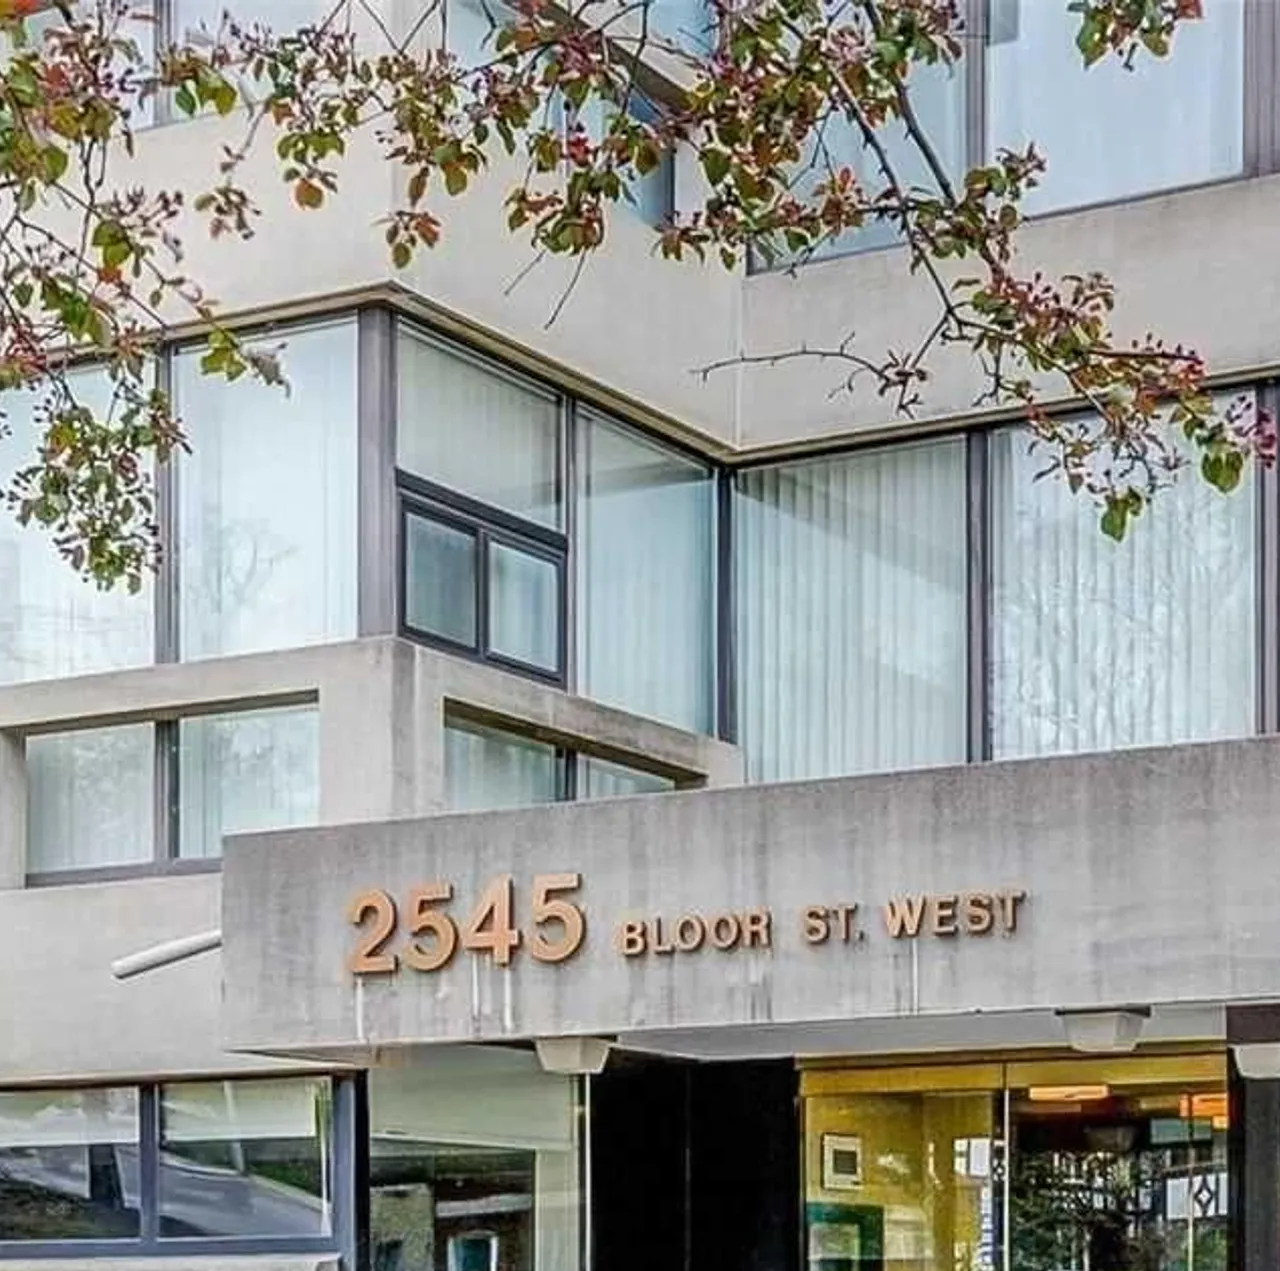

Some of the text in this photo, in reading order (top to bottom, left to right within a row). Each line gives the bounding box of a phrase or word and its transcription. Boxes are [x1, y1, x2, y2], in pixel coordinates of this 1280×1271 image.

[348, 873, 1028, 974] 2545 BLOOR ST. WEST
